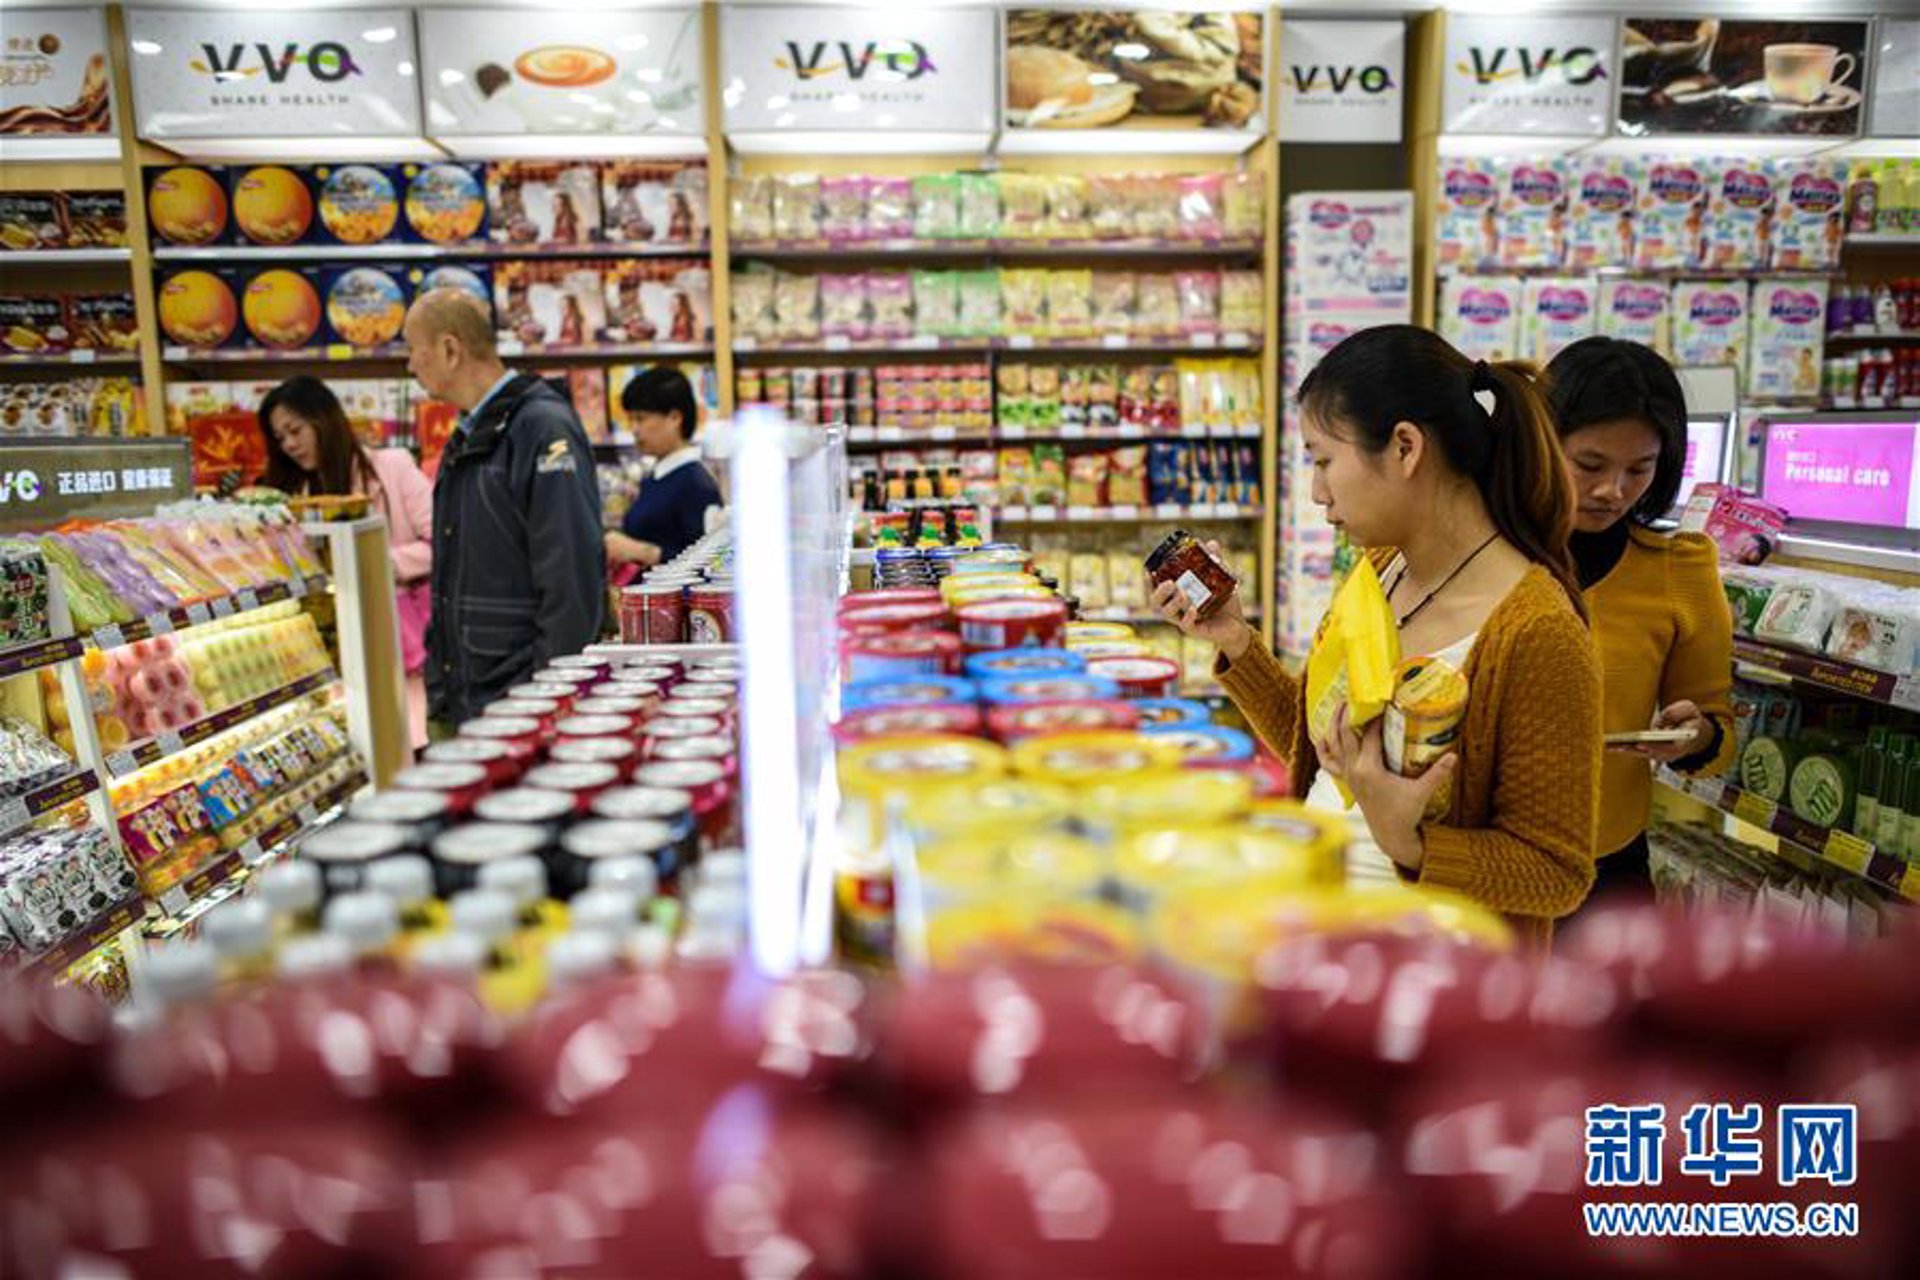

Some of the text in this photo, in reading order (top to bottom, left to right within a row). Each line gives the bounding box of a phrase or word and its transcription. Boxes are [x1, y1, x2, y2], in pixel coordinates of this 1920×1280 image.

[200, 41, 357, 84] VVO
[784, 40, 931, 80] VVO
[1469, 47, 1603, 84] VVO
[1291, 65, 1393, 94] VVO
[210, 95, 350, 106] SHARE HEALTH
[790, 92, 840, 102] SHAR
[1785, 463, 1891, 487] Personal care
